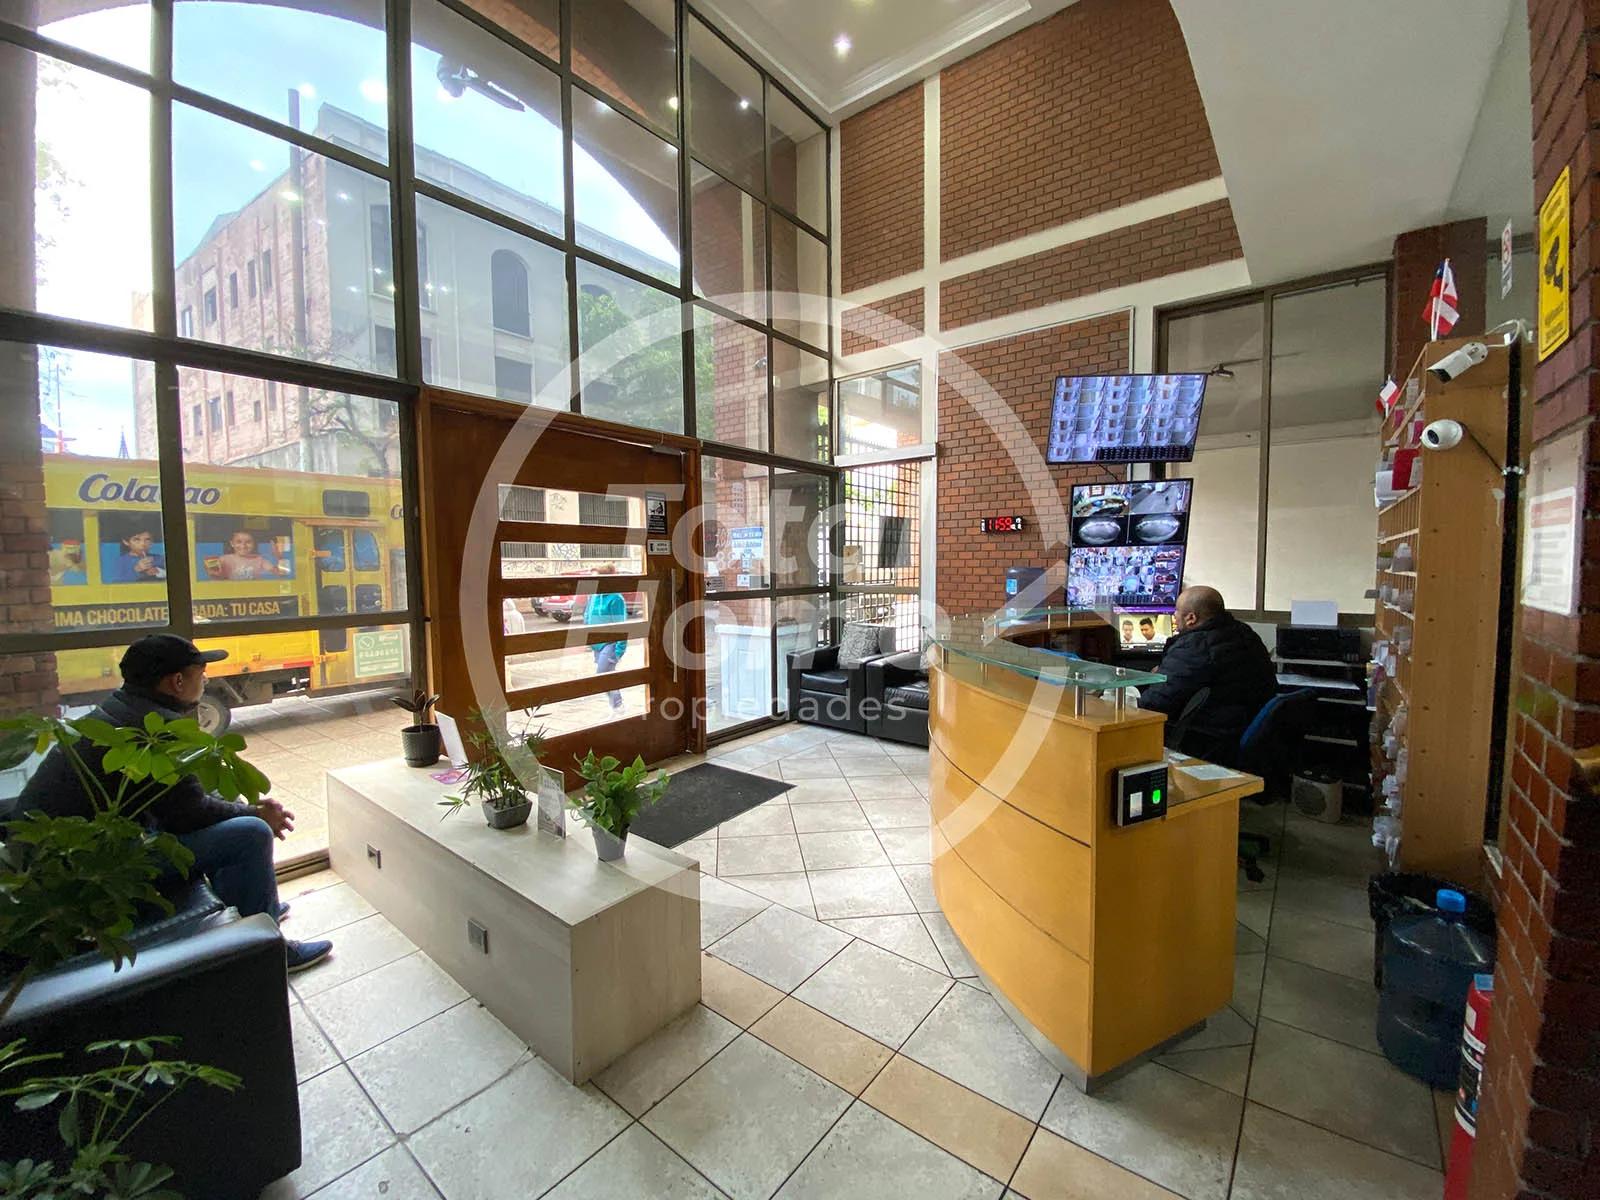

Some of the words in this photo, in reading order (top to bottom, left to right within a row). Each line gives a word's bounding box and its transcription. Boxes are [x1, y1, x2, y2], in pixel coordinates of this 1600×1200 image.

[78, 472, 221, 506] Colaao
[53, 611, 84, 627] IMA
[87, 607, 168, 625] CHOCOLATE
[230, 603, 246, 617] TU
[248, 601, 281, 616] CASA
